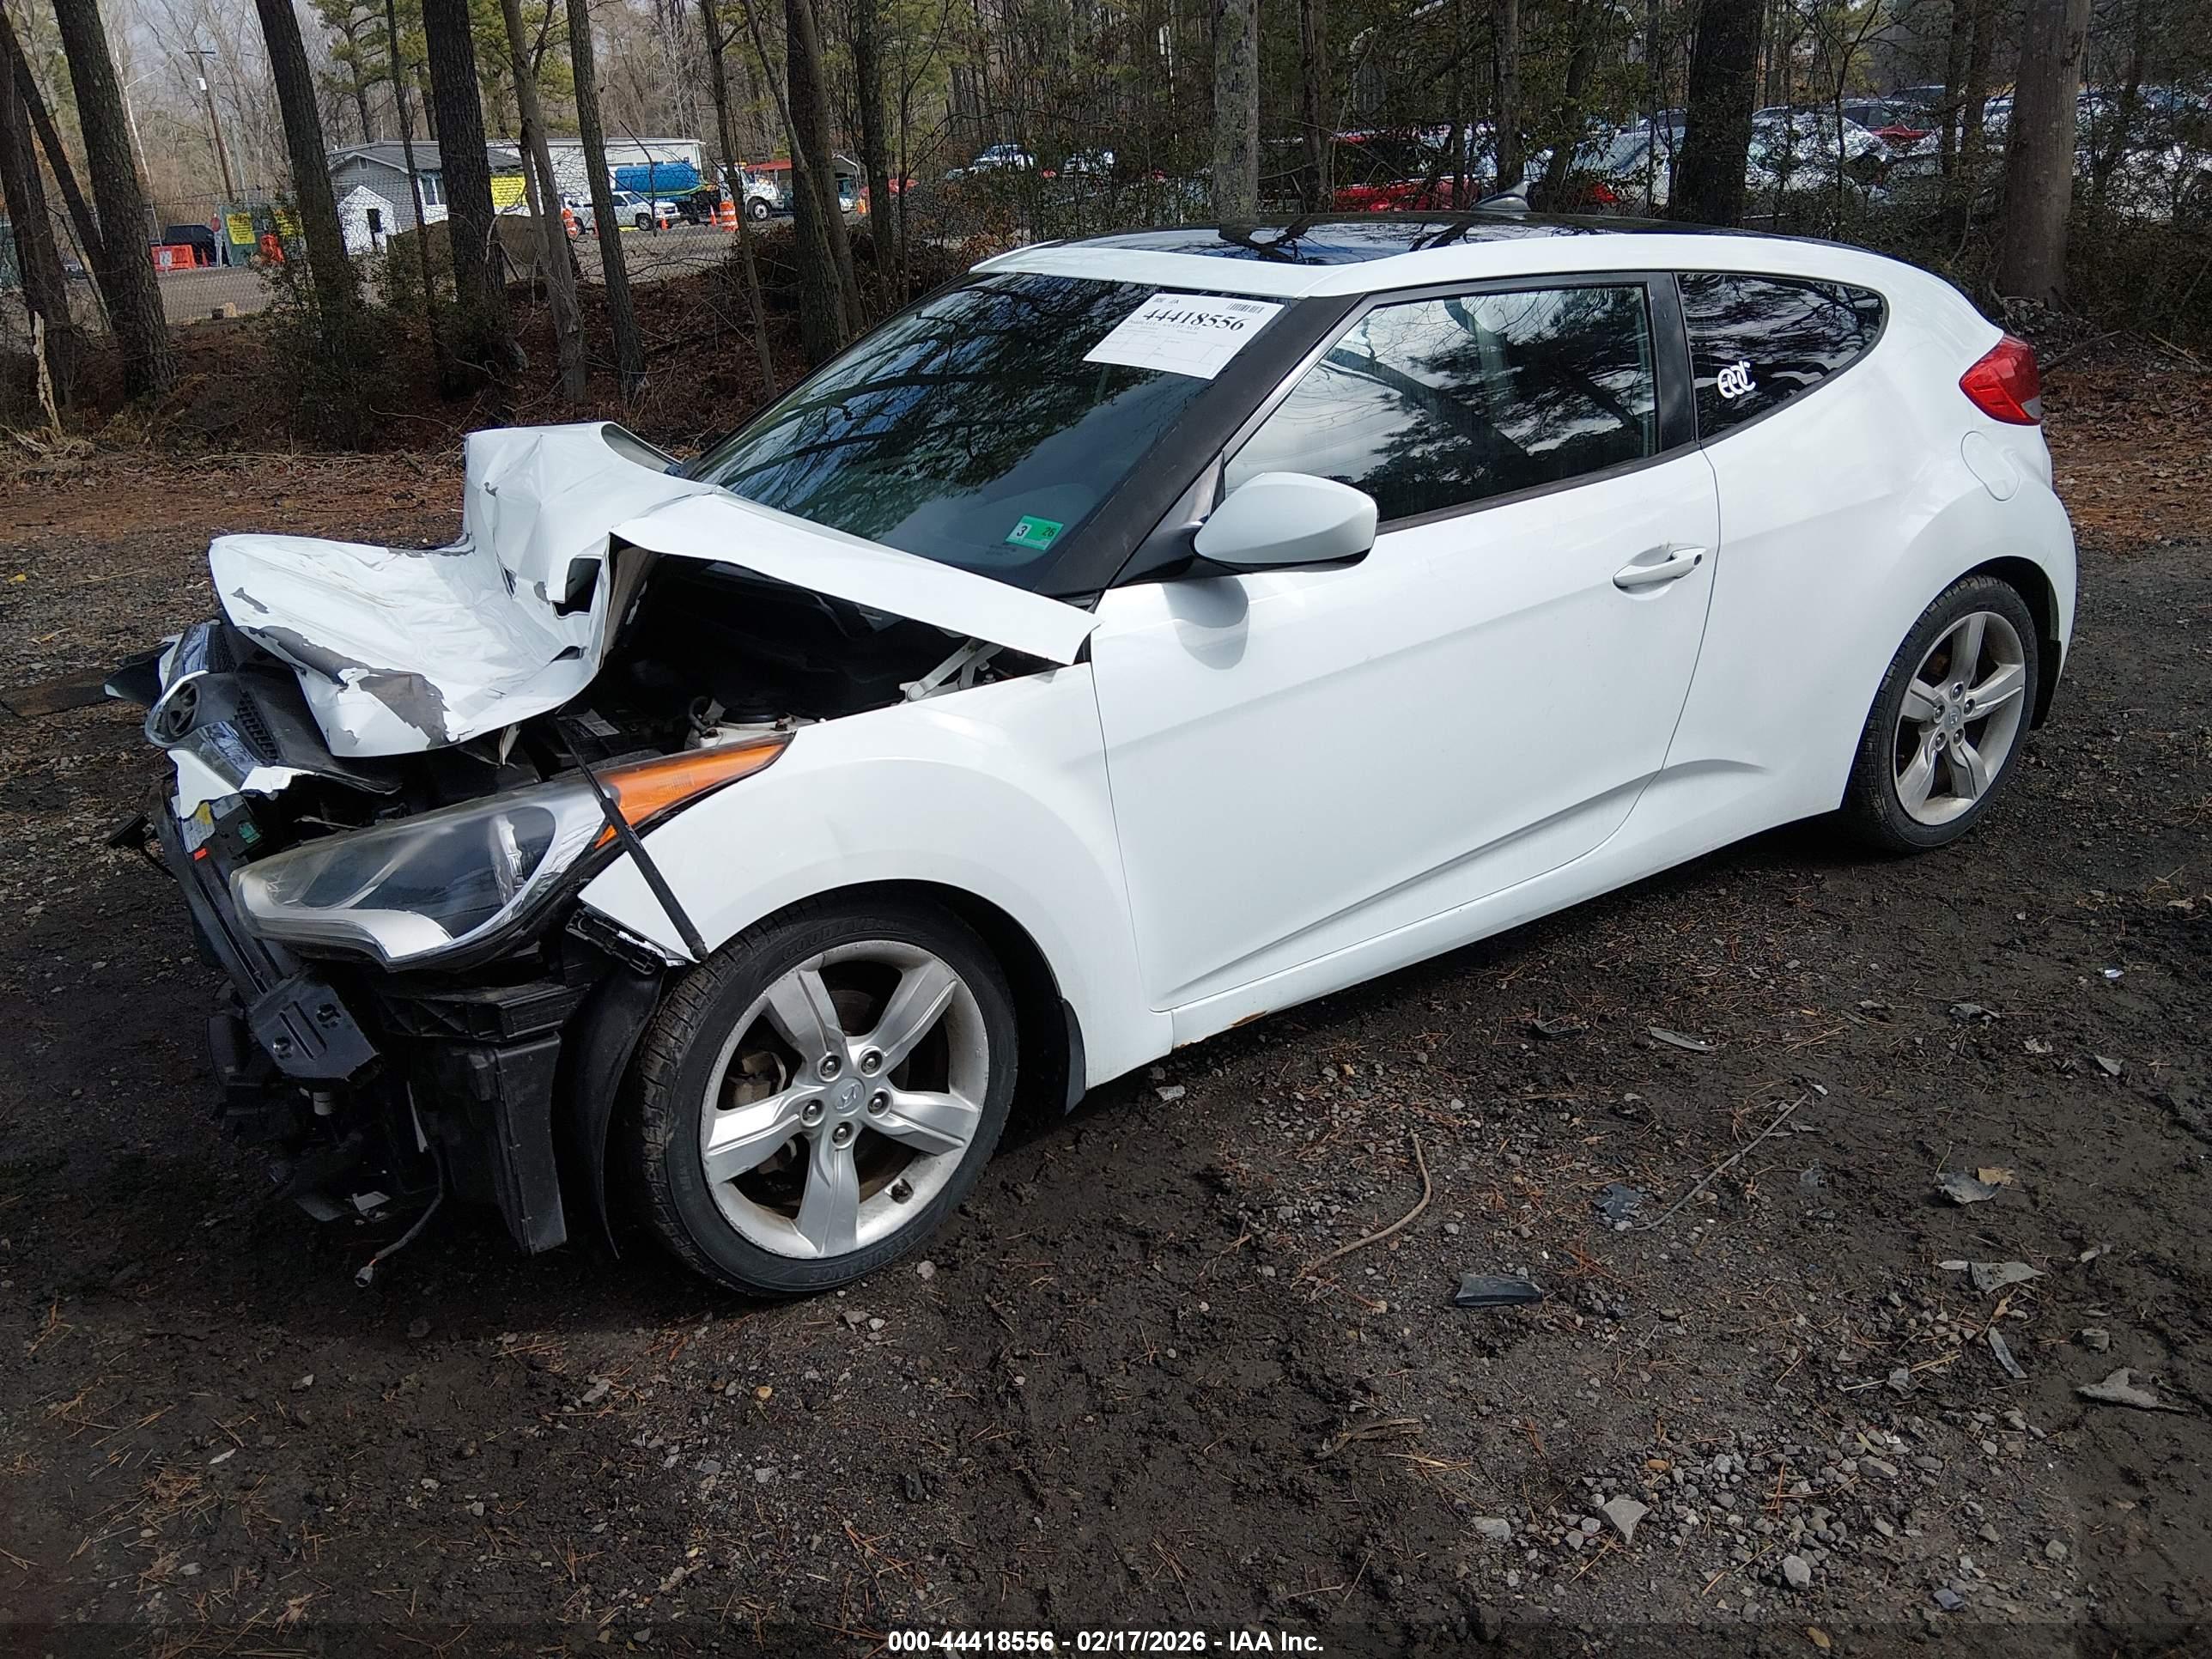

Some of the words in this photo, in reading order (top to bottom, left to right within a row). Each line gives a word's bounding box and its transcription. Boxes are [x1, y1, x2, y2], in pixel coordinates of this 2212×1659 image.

[1142, 308, 1251, 331] 44418556
[1017, 526, 1028, 537] 3
[1042, 526, 1056, 537] 26
